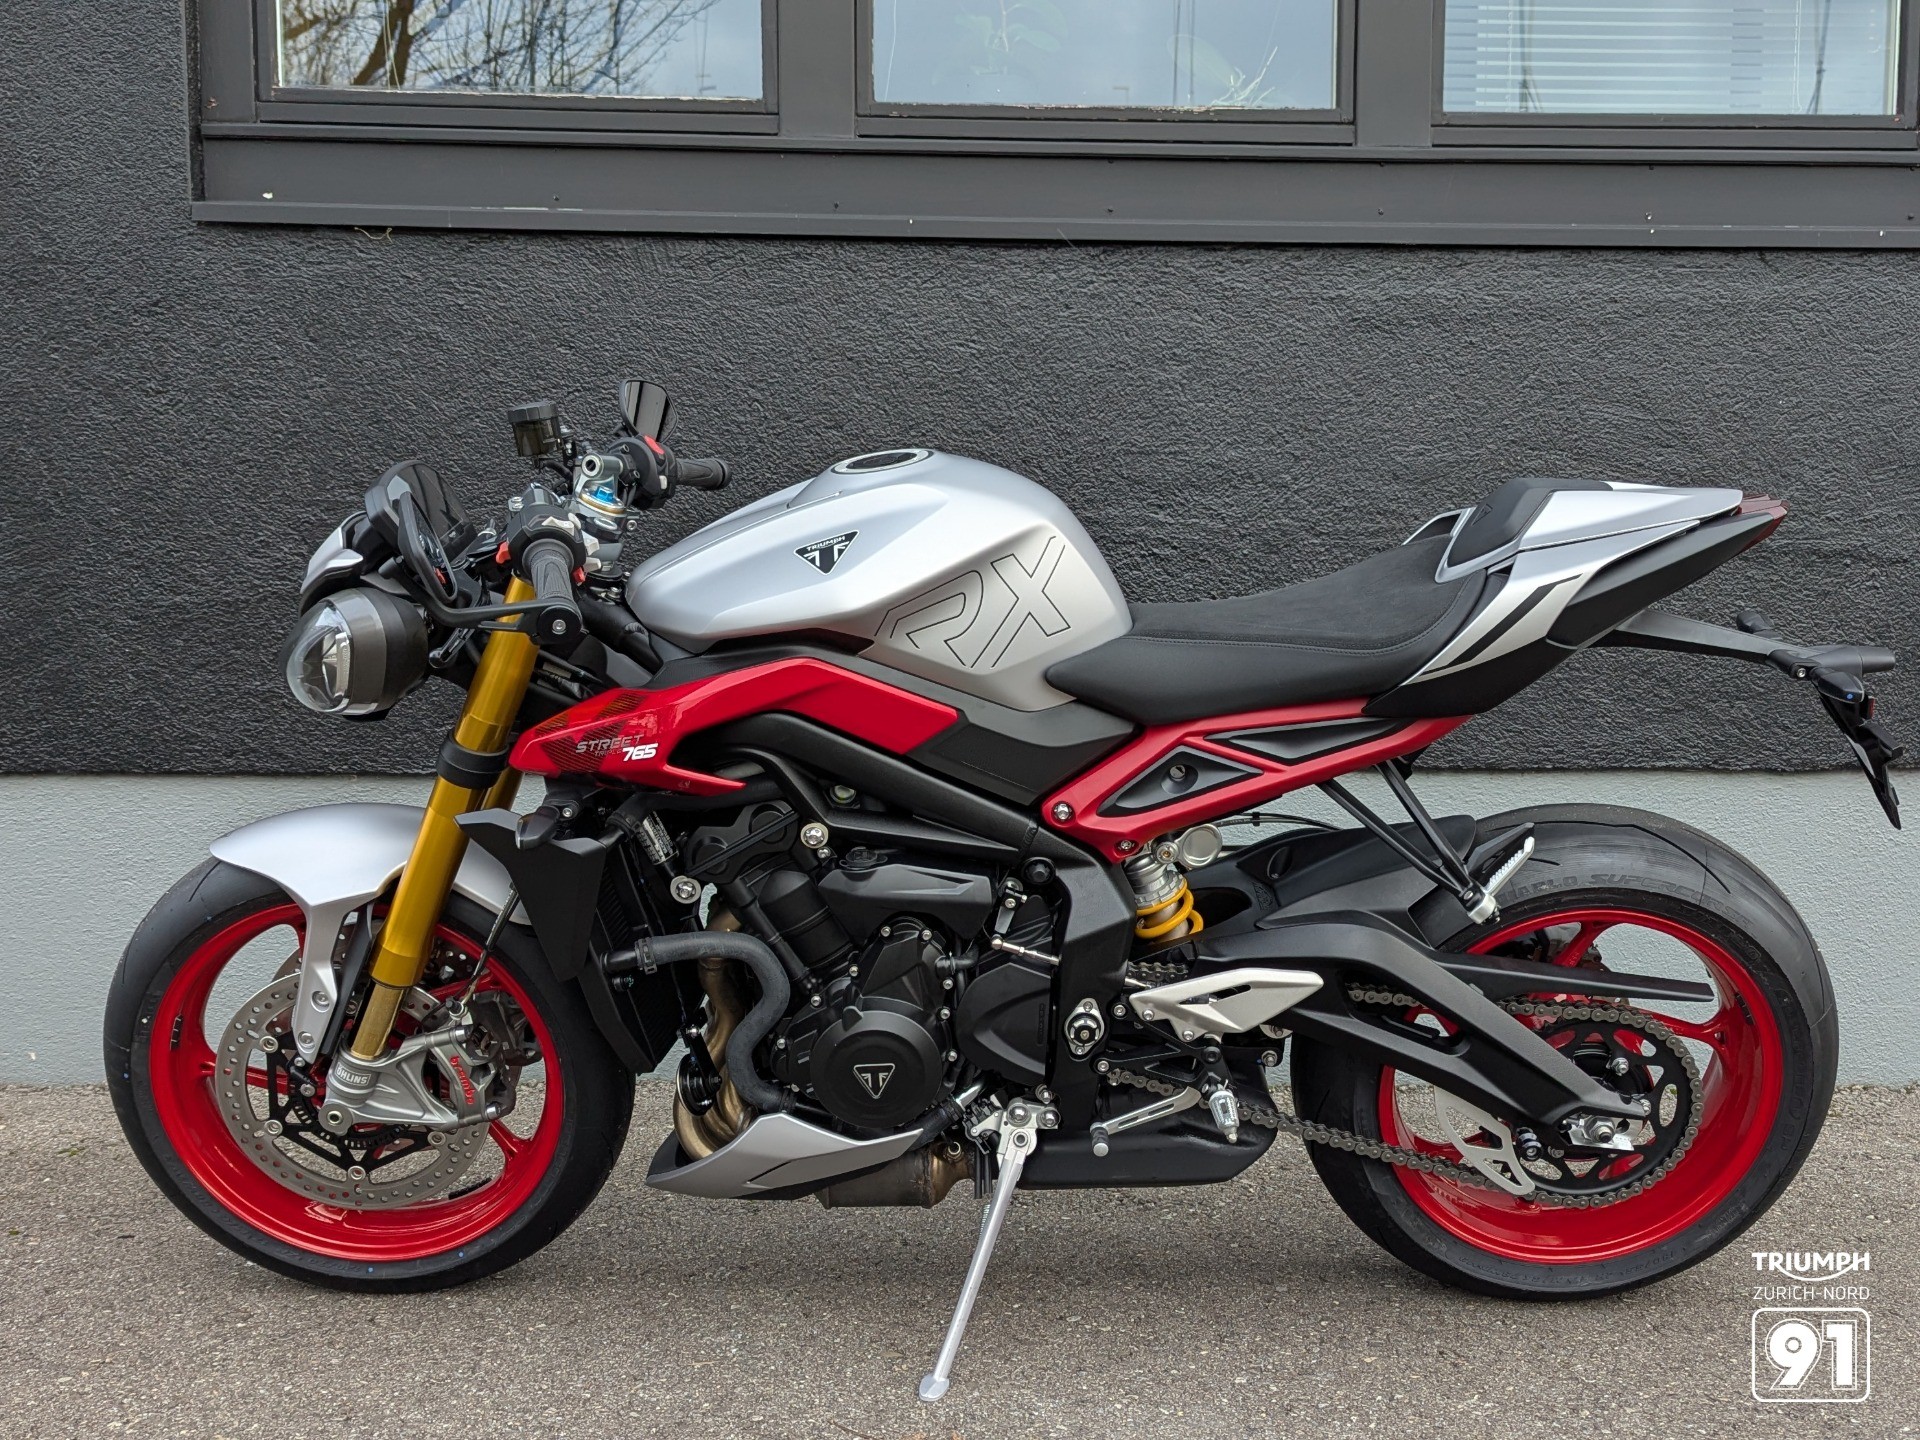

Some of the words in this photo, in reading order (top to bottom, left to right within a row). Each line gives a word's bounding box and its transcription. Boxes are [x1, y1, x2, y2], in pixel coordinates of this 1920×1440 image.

[806, 535, 846, 551] TRIUMPH
[874, 535, 1072, 669] RX
[576, 735, 644, 753] STREET
[622, 743, 658, 761] 765
[450, 1055, 476, 1105] brembo
